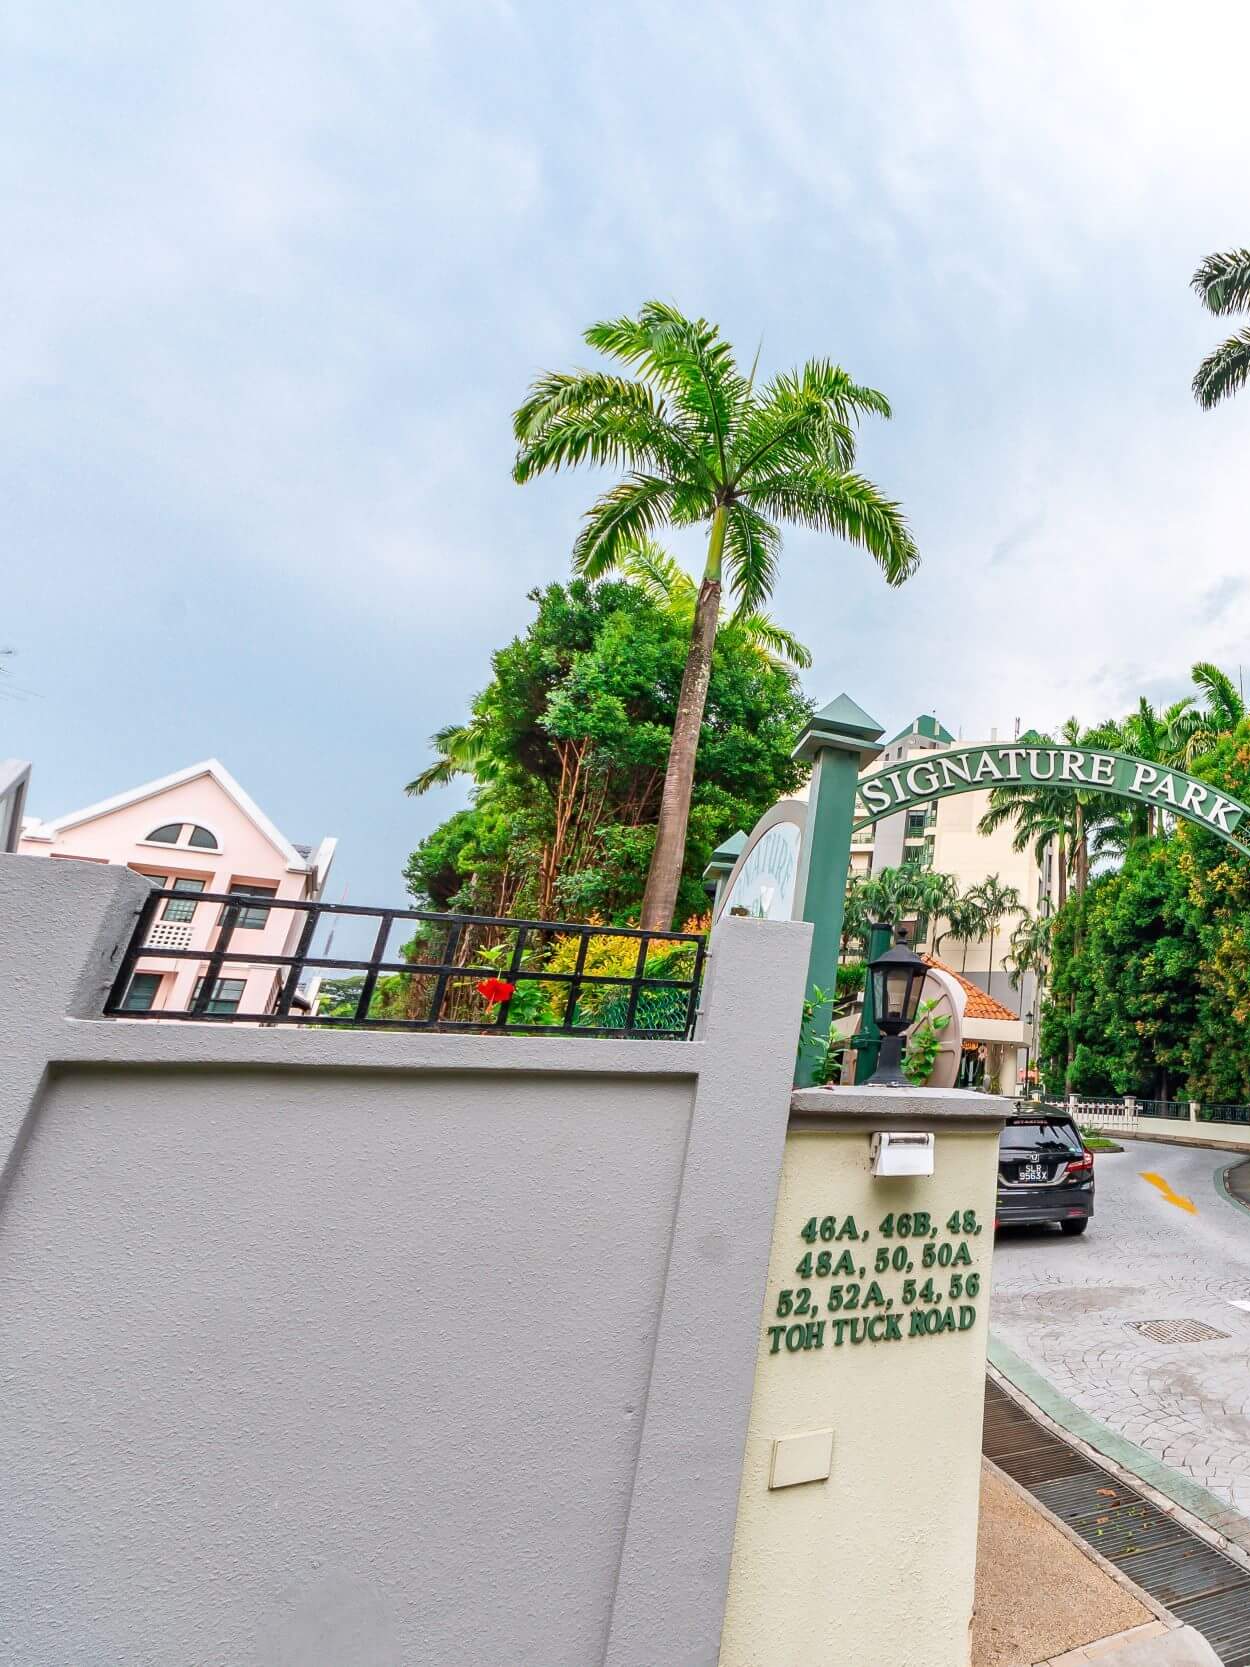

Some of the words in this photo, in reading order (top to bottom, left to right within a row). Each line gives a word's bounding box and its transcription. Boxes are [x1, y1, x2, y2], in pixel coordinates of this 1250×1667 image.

[862, 748, 1116, 814] SIGNATURE
[1128, 762, 1243, 835] PARK
[1025, 1163, 1043, 1173] SLR
[800, 1215, 870, 1243] 46A,
[879, 1211, 938, 1239] 46B,
[946, 1209, 982, 1236] 48,
[796, 1249, 866, 1279] 48A,
[874, 1246, 914, 1274] 50,
[922, 1241, 972, 1268] 50A
[775, 1287, 819, 1318] 52,
[826, 1281, 893, 1312] 52A,
[902, 1276, 942, 1305] 54,
[949, 1273, 981, 1299] 56
[768, 1319, 826, 1354] TOH
[832, 1313, 904, 1347] TUCK
[908, 1305, 977, 1338] ROAD
